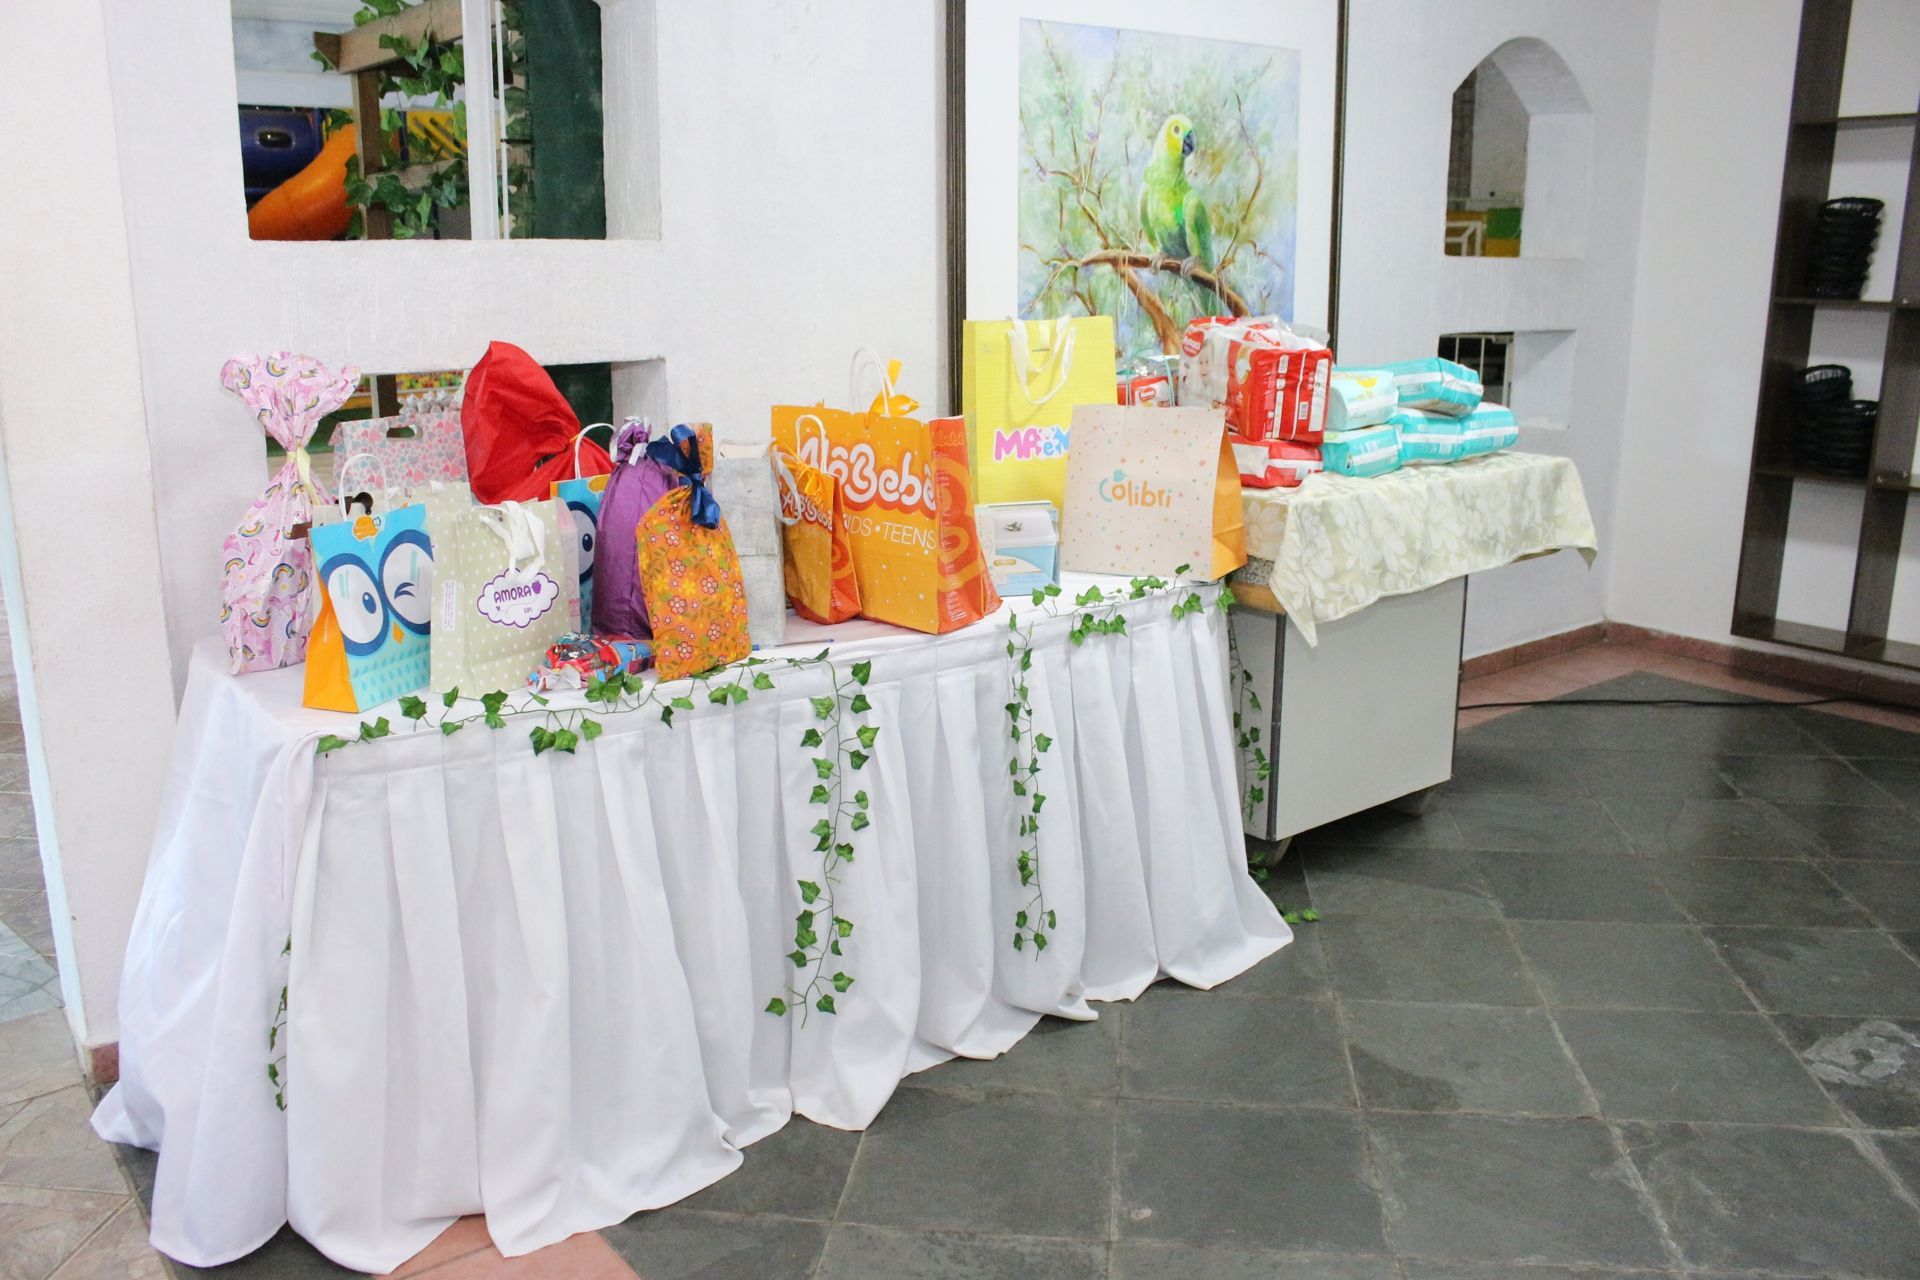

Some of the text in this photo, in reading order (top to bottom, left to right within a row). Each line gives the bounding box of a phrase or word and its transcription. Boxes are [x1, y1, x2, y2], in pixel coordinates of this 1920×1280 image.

[1099, 470, 1172, 508] Colibri
[883, 521, 937, 550] TEENS
[493, 585, 532, 603] AMORA
